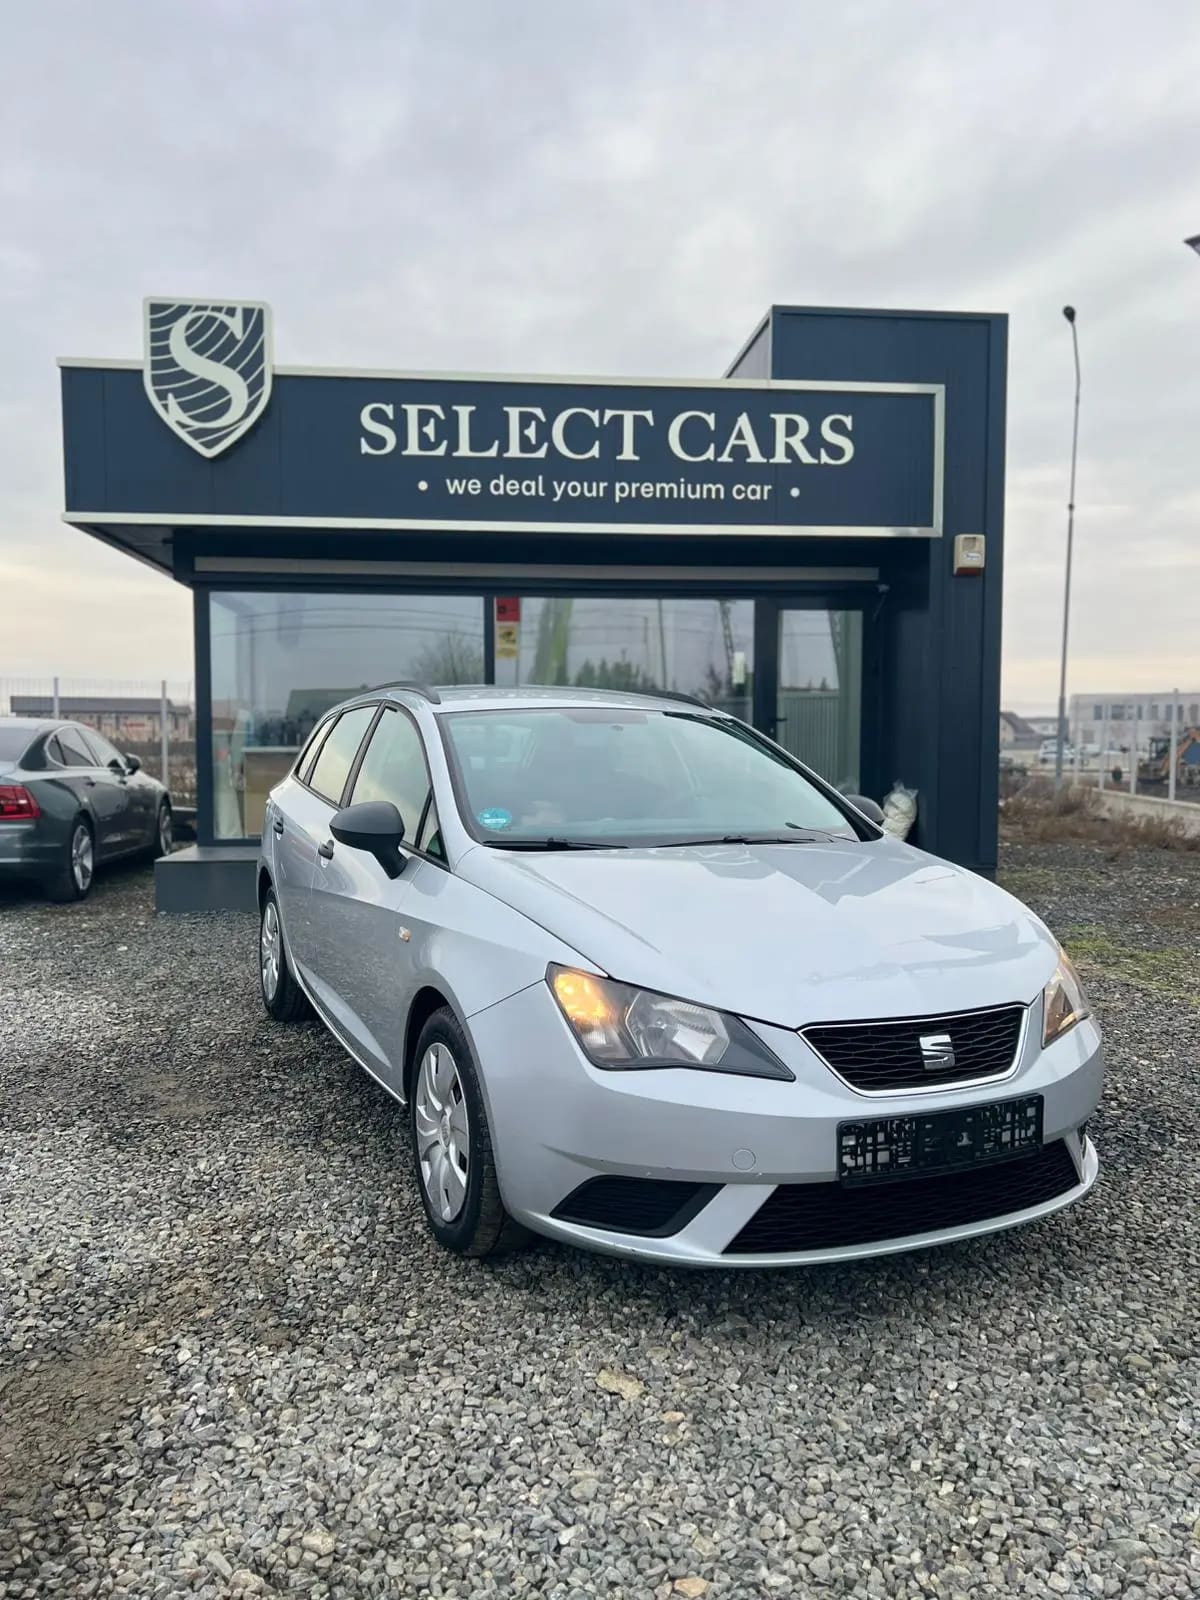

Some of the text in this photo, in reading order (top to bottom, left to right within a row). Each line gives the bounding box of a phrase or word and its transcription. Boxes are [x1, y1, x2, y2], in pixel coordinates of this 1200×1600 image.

[167, 306, 249, 428] S
[360, 402, 855, 466] SELECT CARS
[445, 474, 773, 504] we deal your premium car
